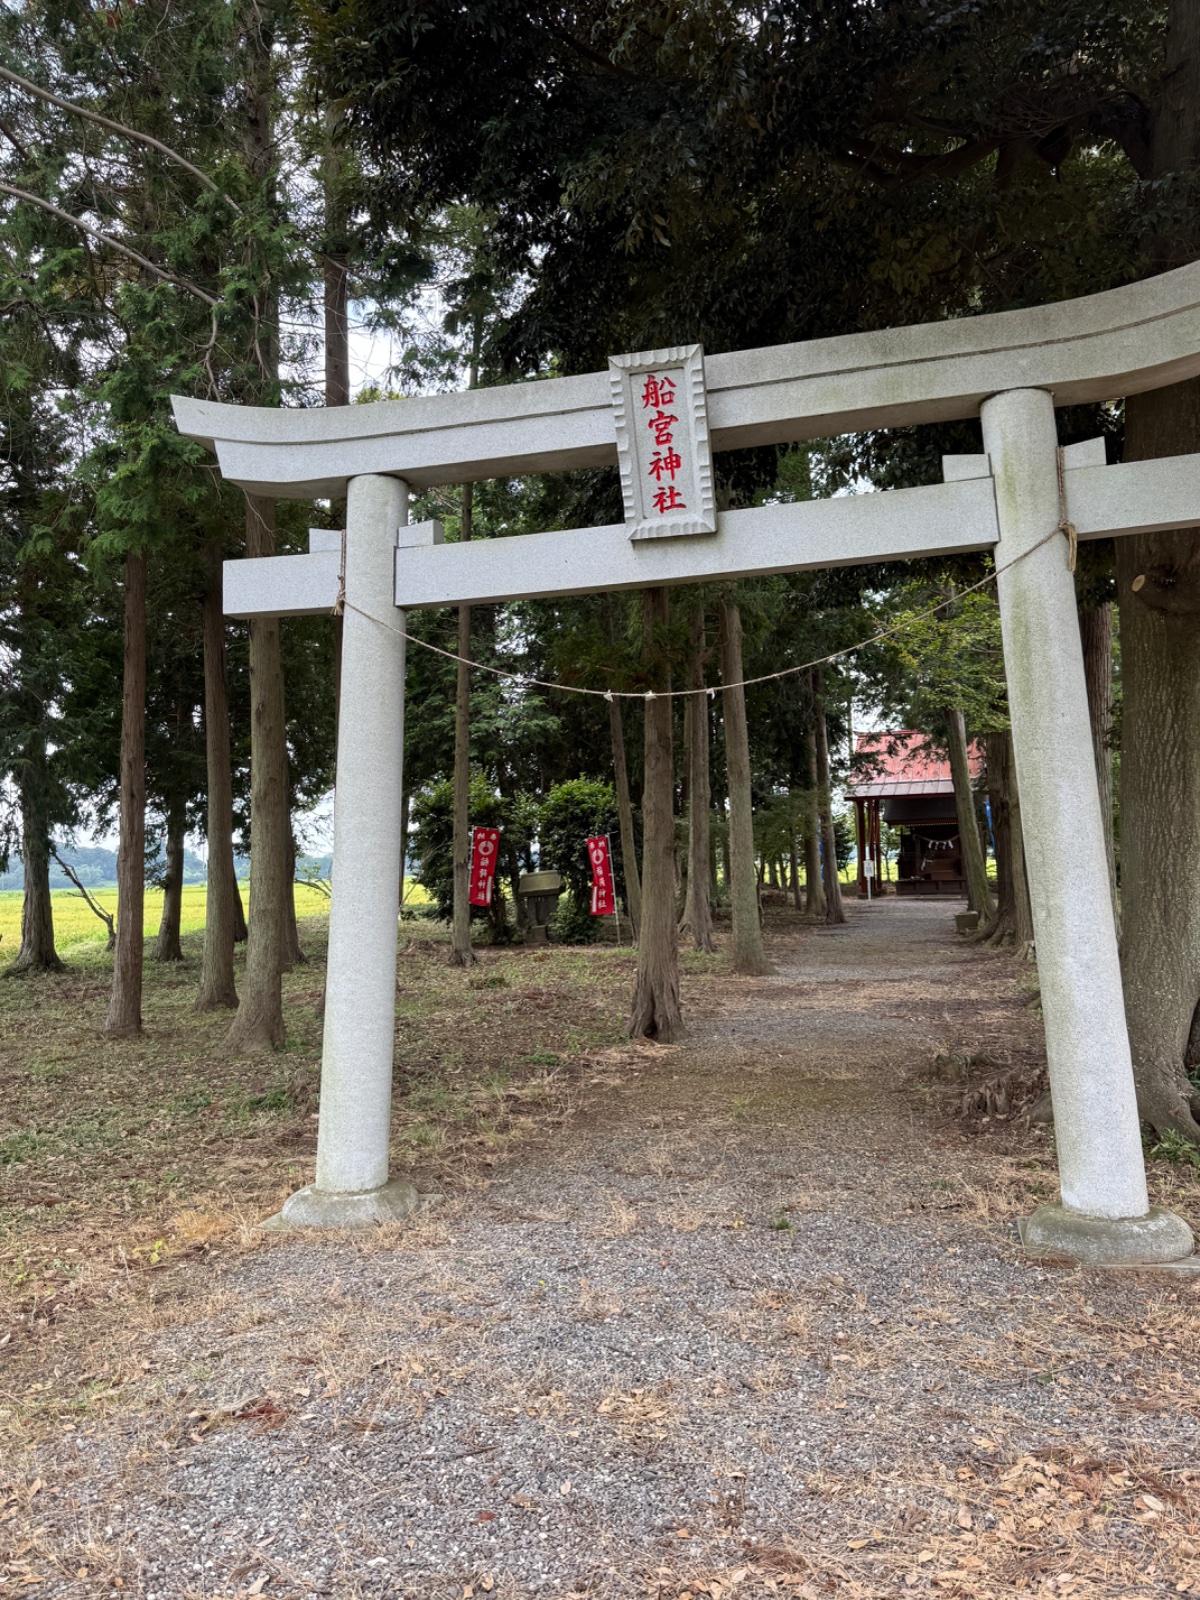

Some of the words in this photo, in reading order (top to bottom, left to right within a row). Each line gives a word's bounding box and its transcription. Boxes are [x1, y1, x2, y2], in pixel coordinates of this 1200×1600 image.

[641, 374, 687, 514] 船宮神社
[596, 866, 607, 909] 稲荷神社
